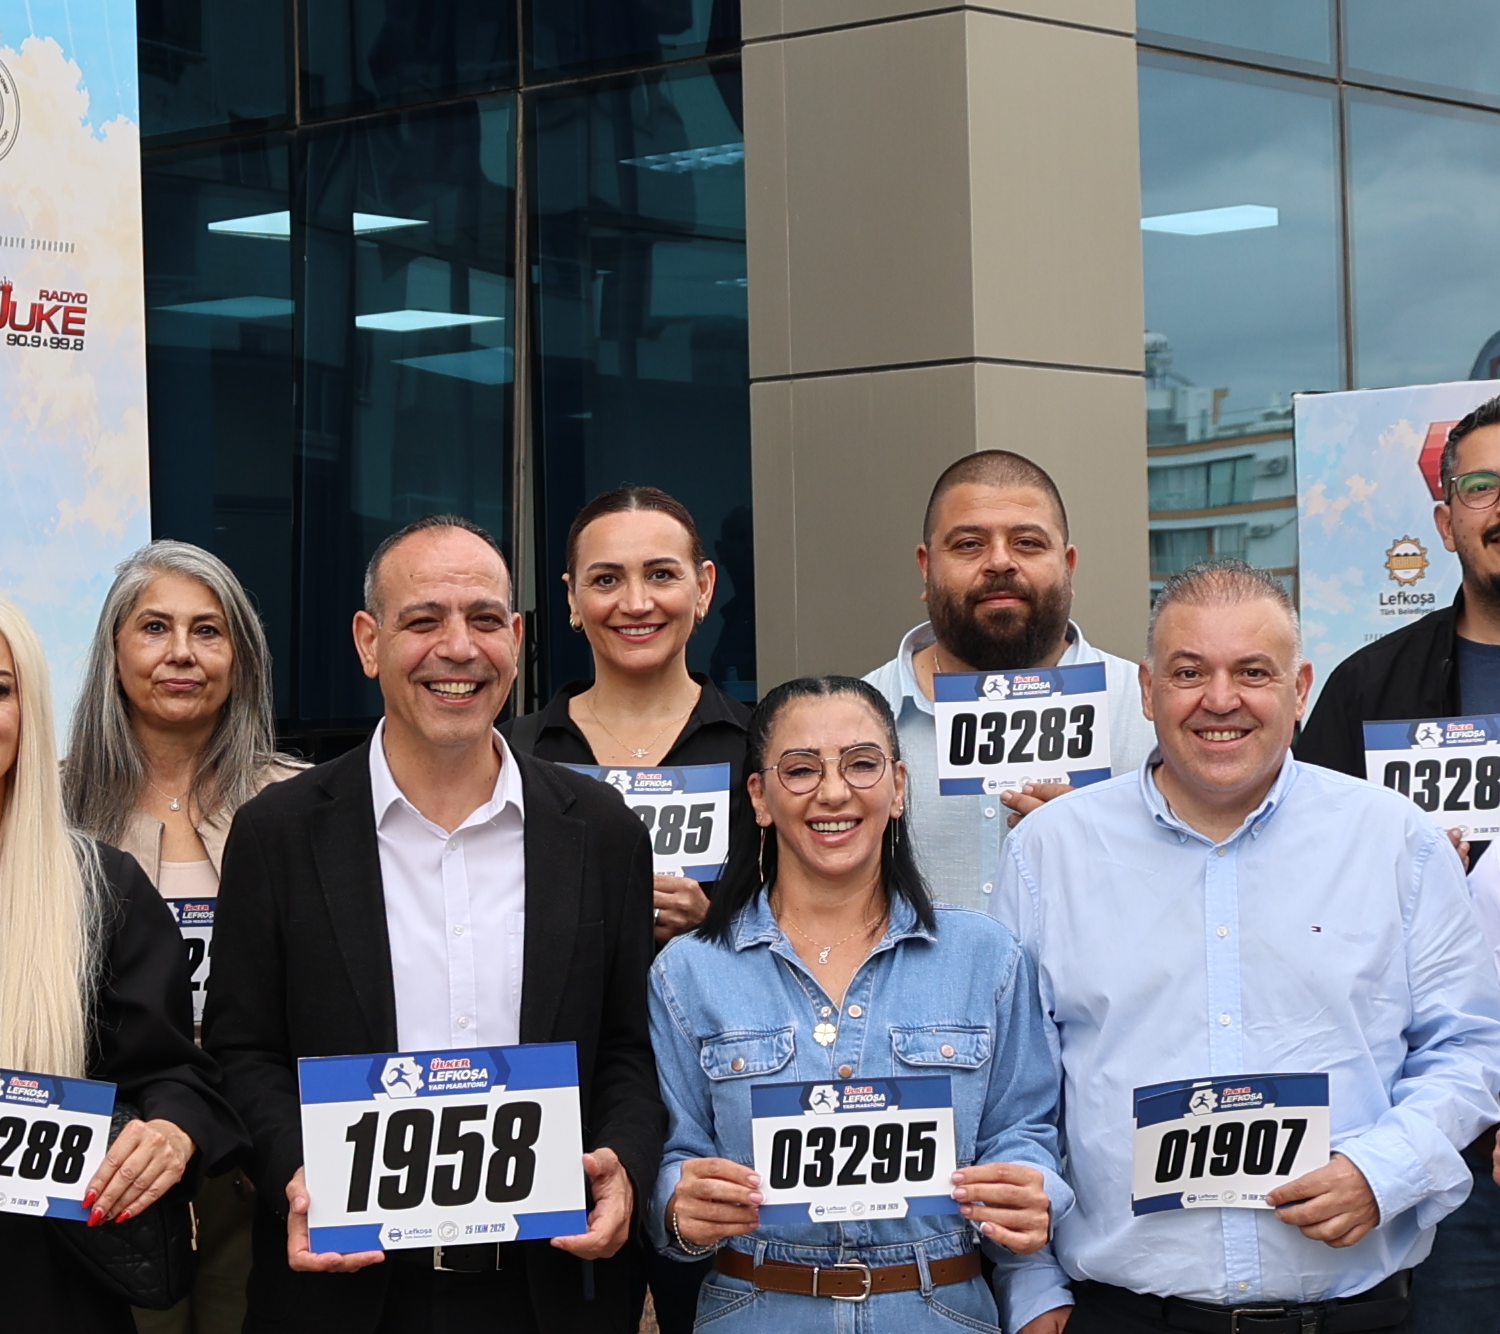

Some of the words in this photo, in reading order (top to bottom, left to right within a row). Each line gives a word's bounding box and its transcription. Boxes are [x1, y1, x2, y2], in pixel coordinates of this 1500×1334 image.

[38, 289, 88, 305] RADYO
[6, 333, 42, 348] 90.9
[49, 337, 84, 351] 99.8
[1379, 591, 1436, 607] Lefkoşa
[949, 704, 1095, 766] 03283
[430, 1057, 471, 1071] ÜLKER
[428, 1068, 488, 1083] LEFKOŞA
[6, 1085, 49, 1099] LEFKOŞA
[345, 1101, 542, 1213] 1958
[769, 1121, 938, 1190] 03295
[1155, 1118, 1308, 1184] 01907
